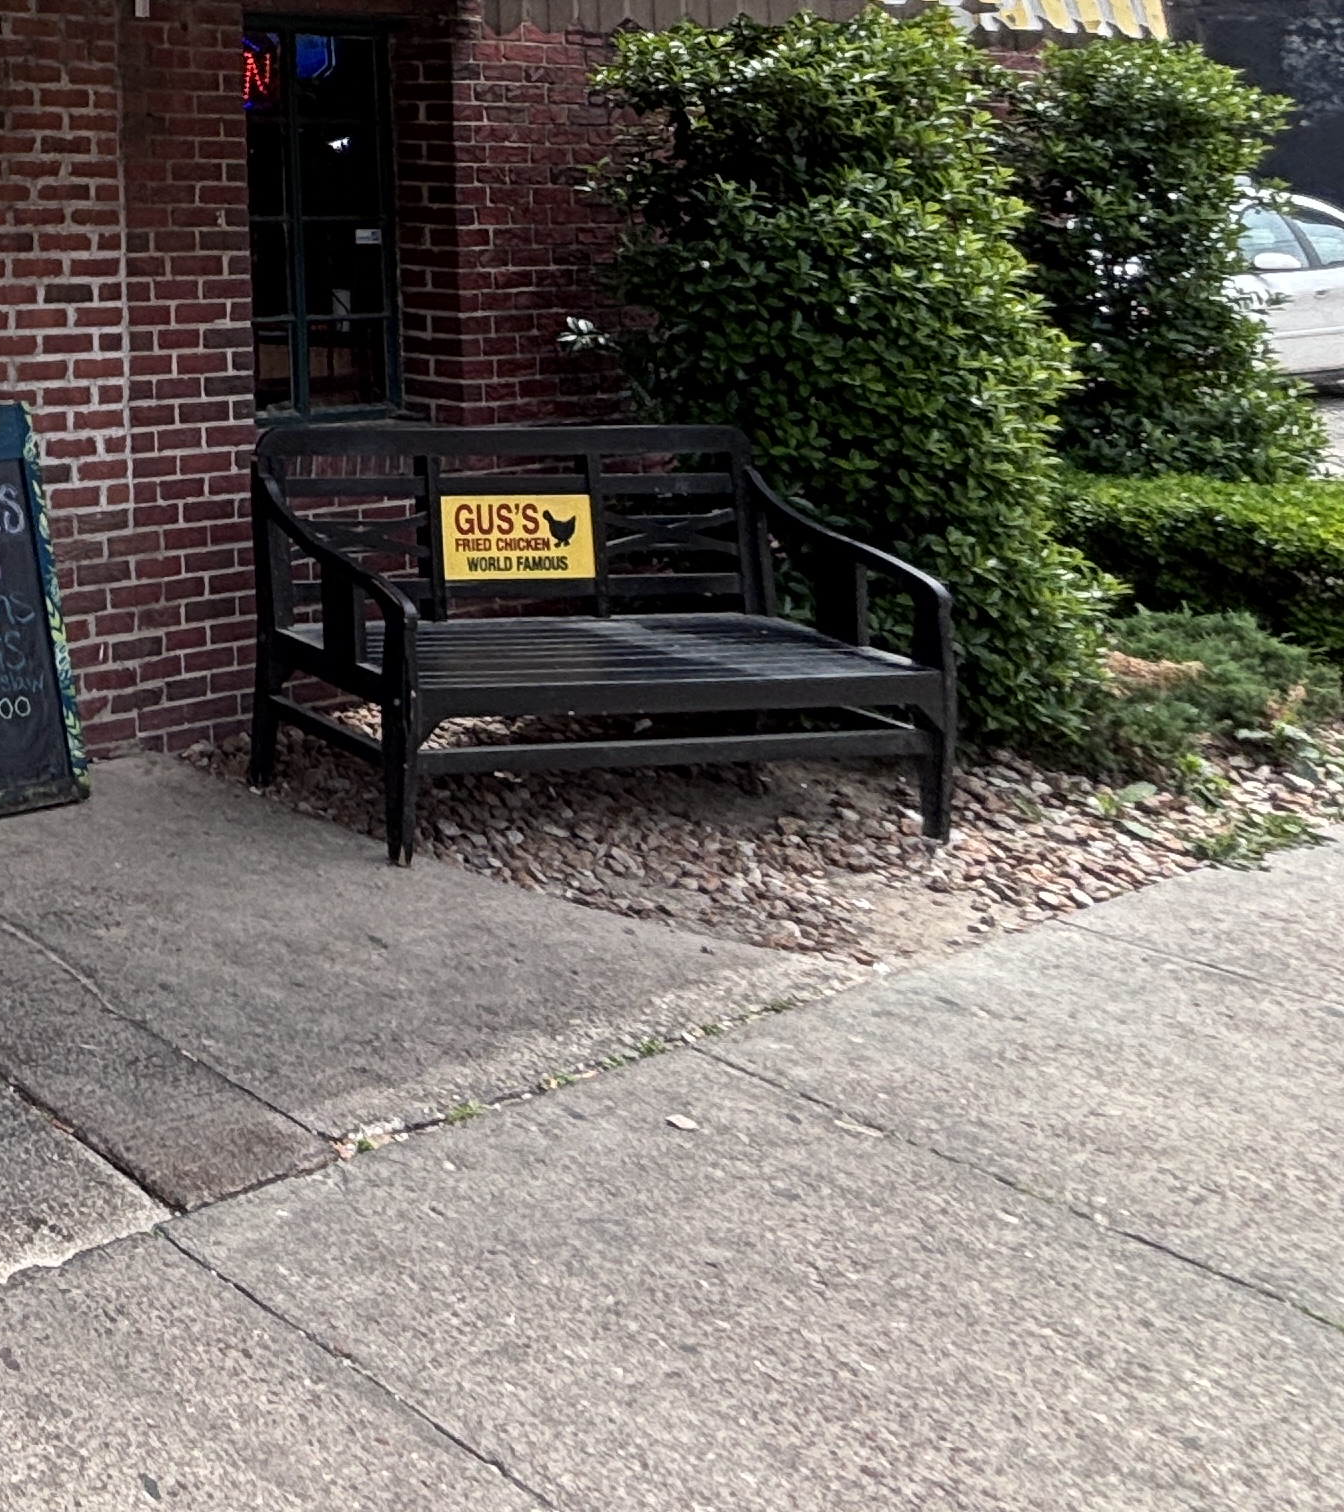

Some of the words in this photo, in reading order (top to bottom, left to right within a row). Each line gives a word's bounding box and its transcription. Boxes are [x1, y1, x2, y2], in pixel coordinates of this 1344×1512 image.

[455, 503, 540, 535] GUS'S
[455, 538, 492, 552] FRIED
[496, 537, 551, 551] CHICKEN
[467, 556, 512, 572] WORLD
[516, 556, 569, 571] FAMOUS
